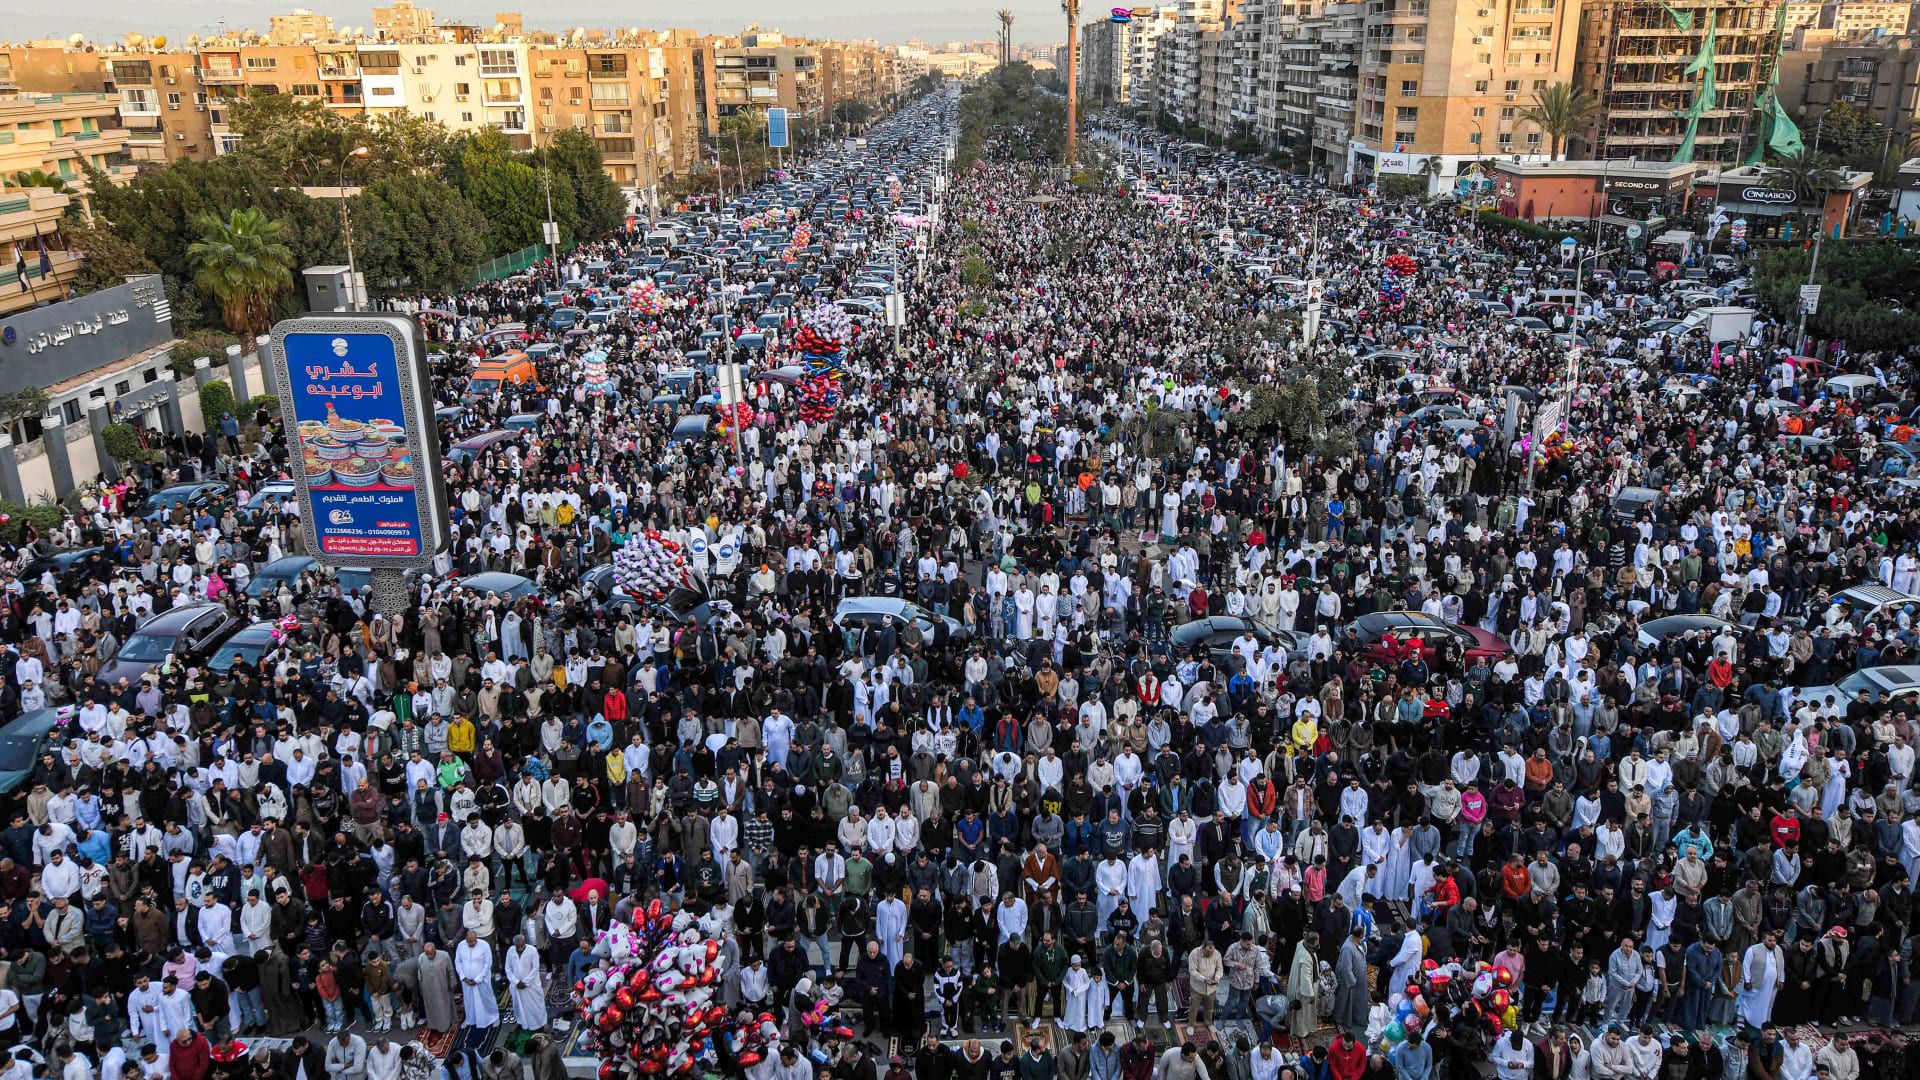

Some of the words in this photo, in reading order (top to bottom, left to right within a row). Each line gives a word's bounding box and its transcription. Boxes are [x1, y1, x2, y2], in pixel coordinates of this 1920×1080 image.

[1614, 181, 1643, 189] SECOND
[75, 314, 103, 334] شرطة
[106, 309, 129, 325] نقطة
[28, 324, 75, 354] الشيراتون
[306, 361, 378, 381] كشري
